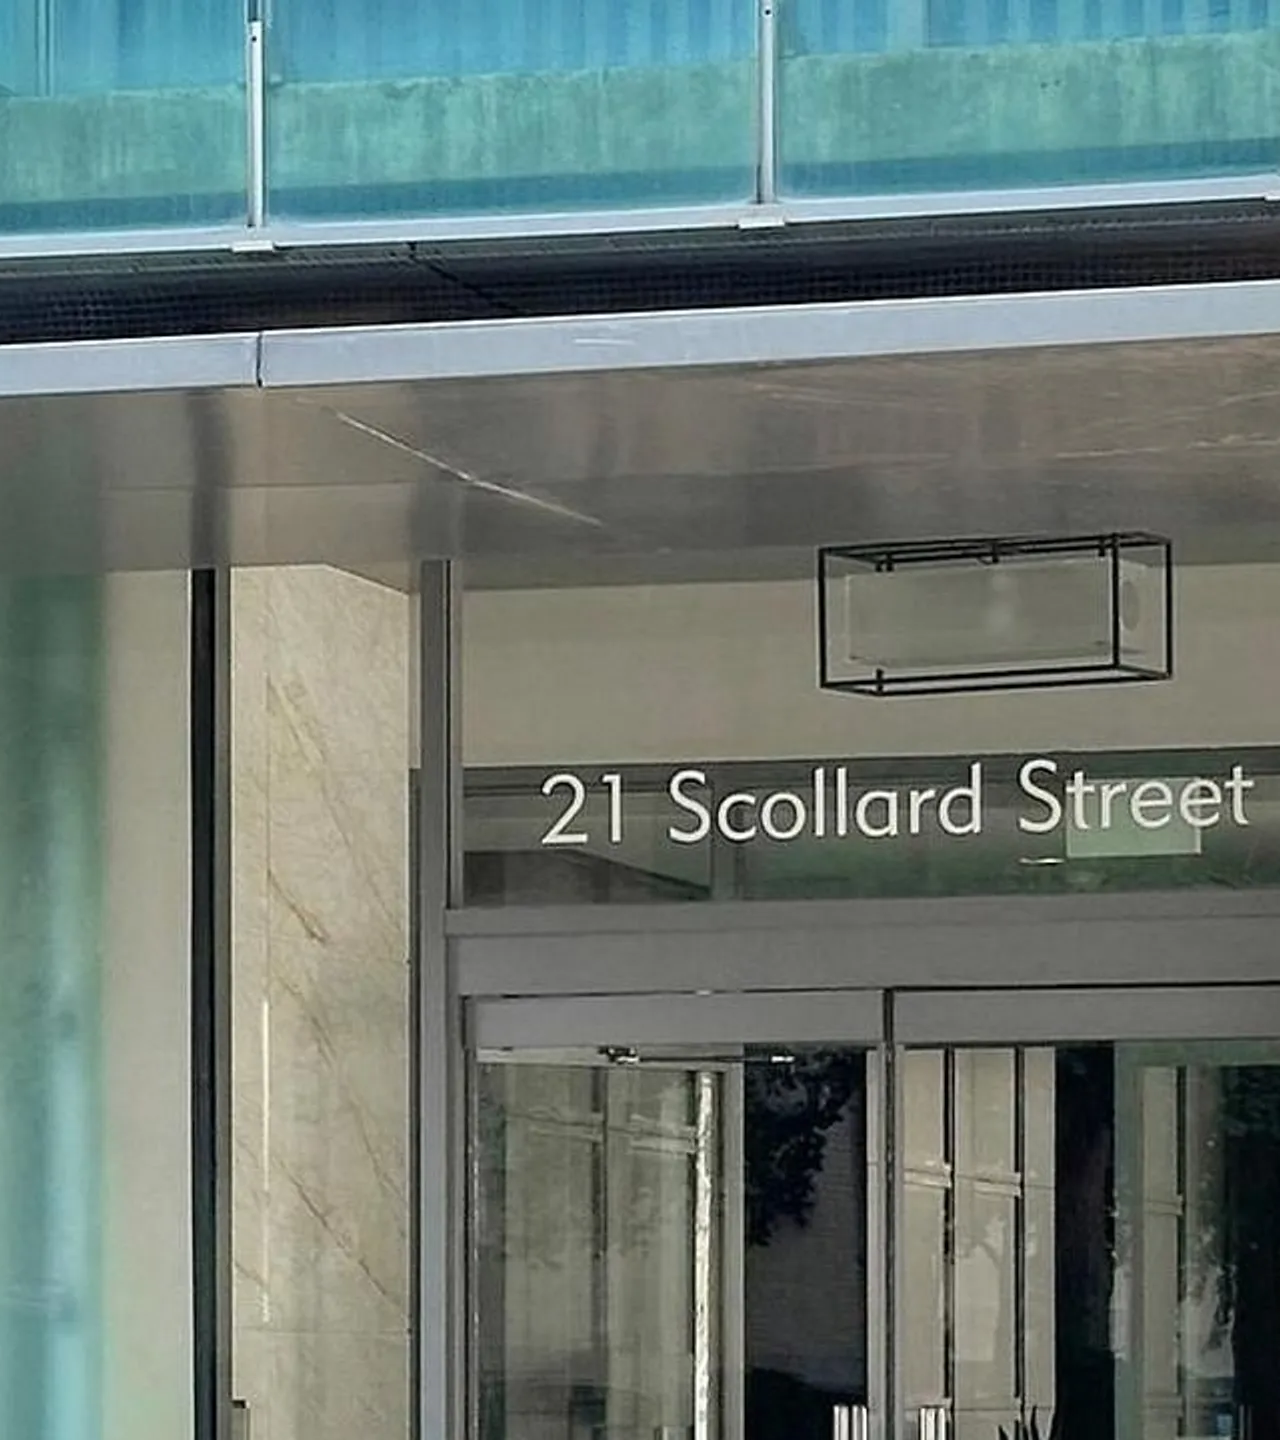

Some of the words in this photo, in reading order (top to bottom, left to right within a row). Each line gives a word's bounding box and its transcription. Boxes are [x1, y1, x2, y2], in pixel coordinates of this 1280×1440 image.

[541, 773, 622, 845] 21
[669, 763, 982, 843] Scollard
[1019, 758, 1255, 833] Street
